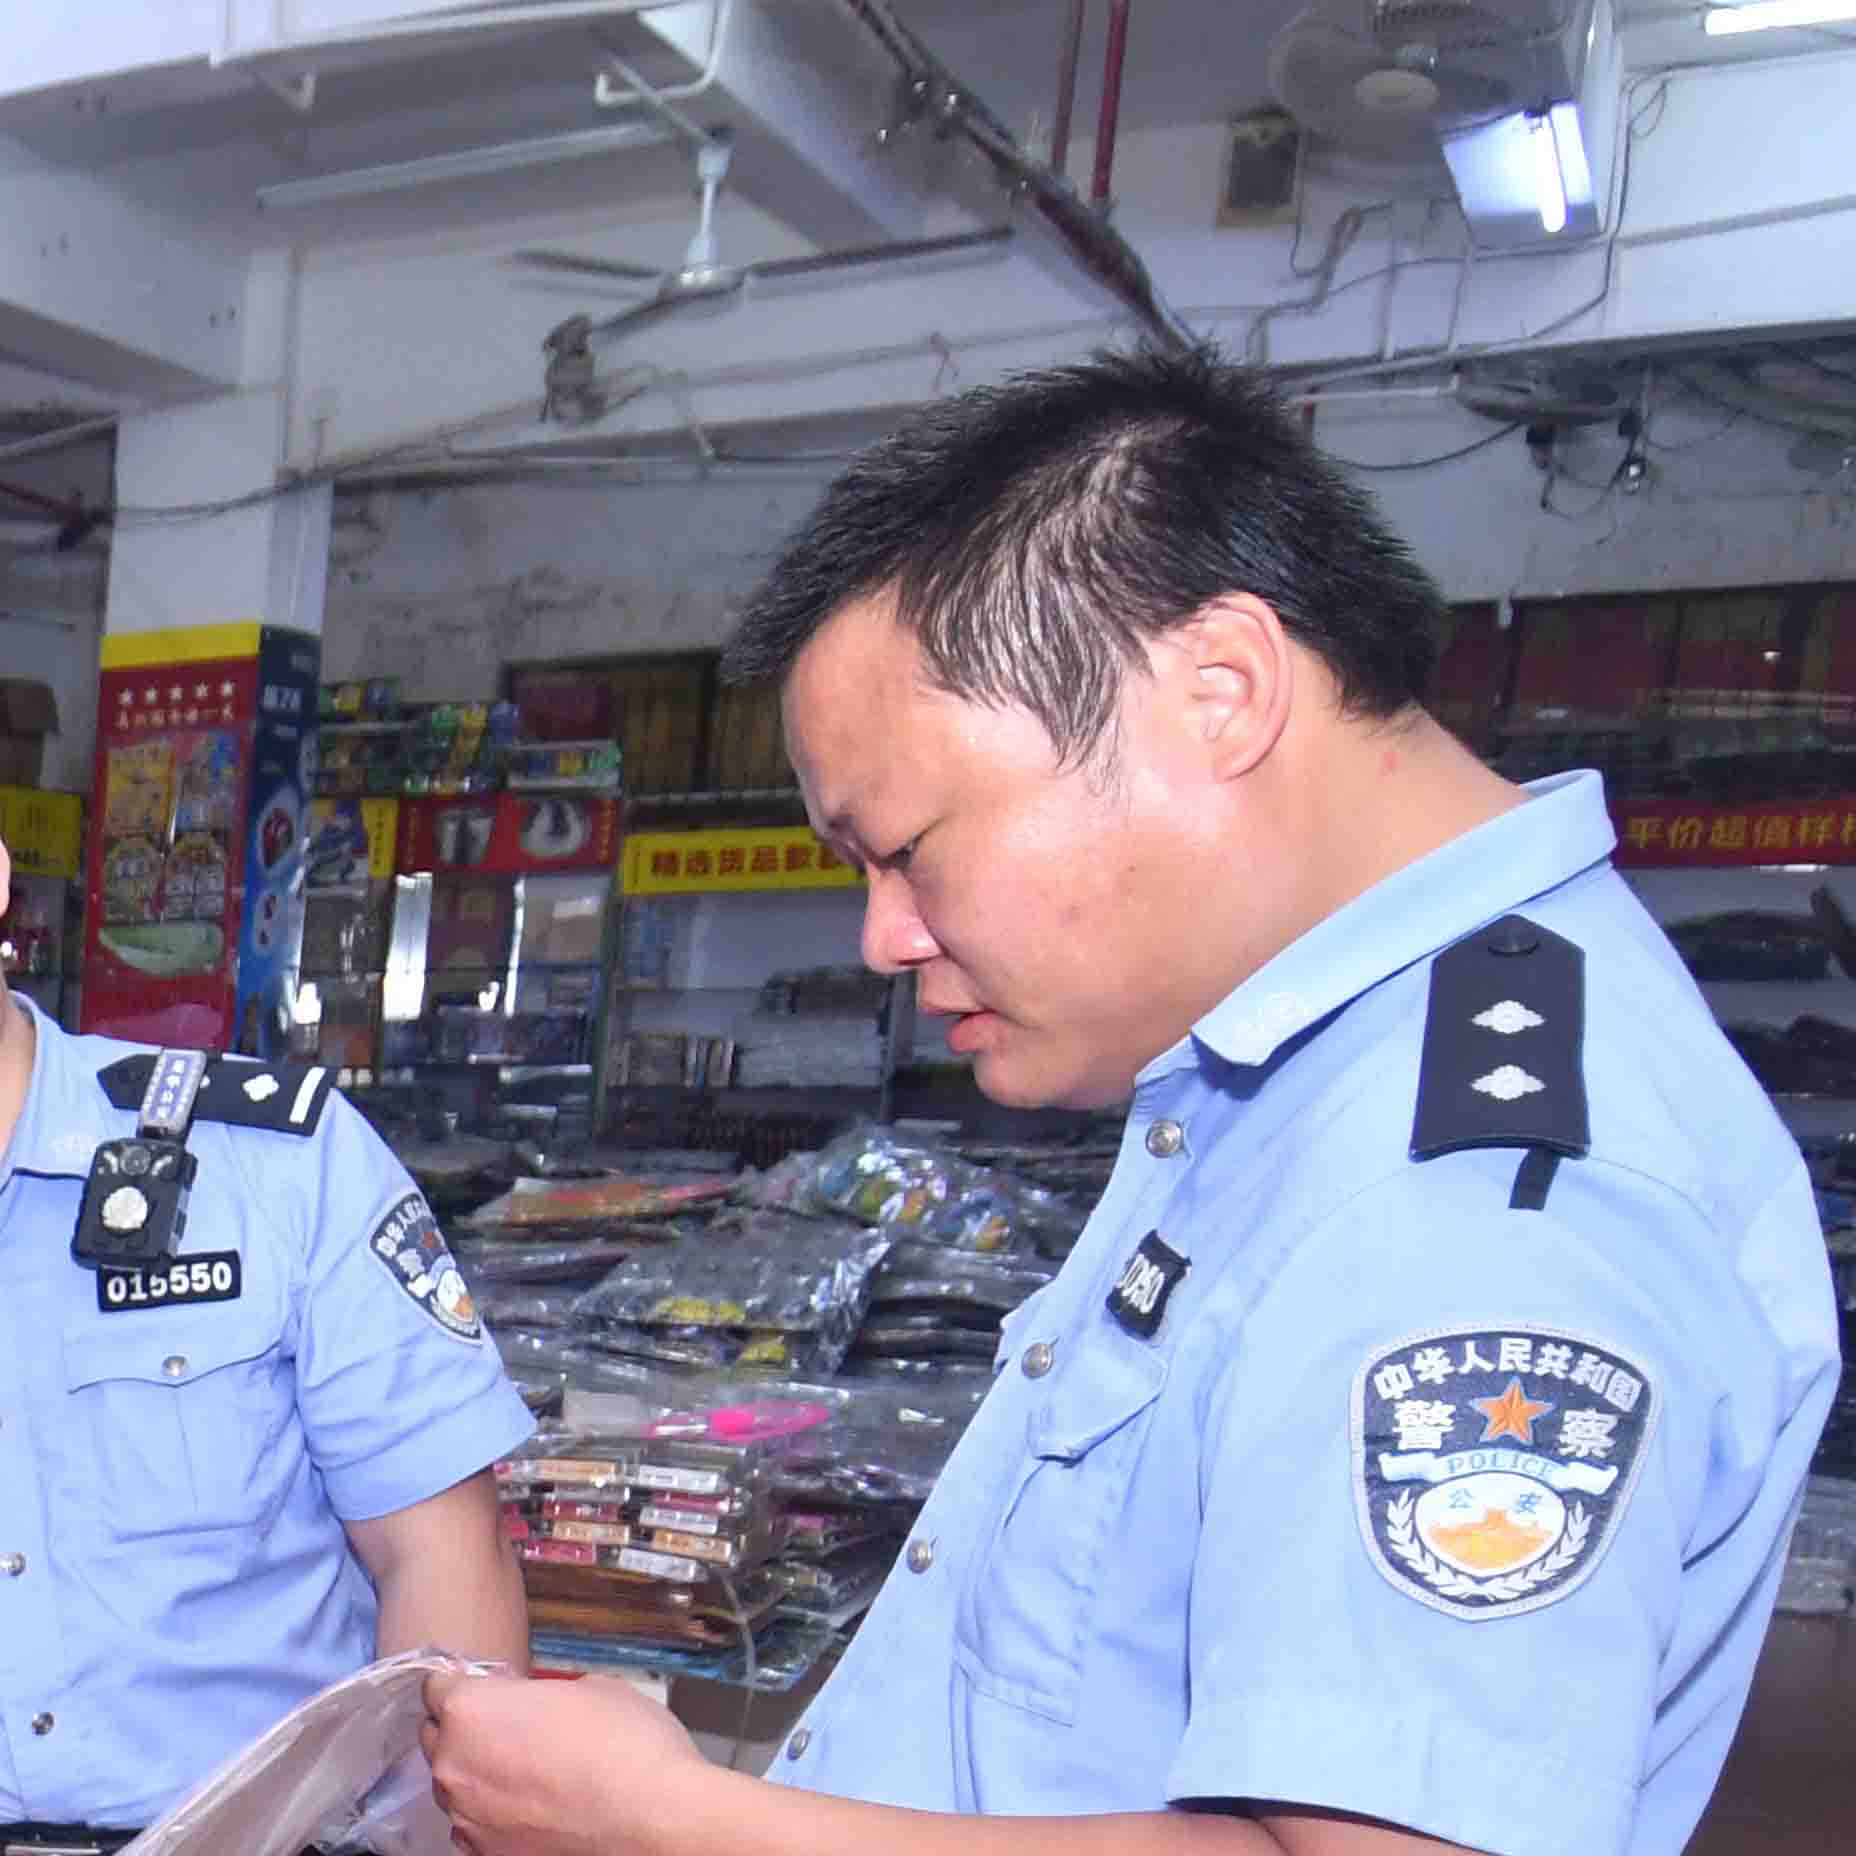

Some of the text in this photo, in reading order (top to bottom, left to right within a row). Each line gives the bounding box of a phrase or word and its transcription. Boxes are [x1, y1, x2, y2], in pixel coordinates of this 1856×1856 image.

[1373, 1337, 1643, 1414] 中华人民共和国
[1393, 1399, 1619, 1459] 警 察
[1447, 1453, 1558, 1479] POLICE
